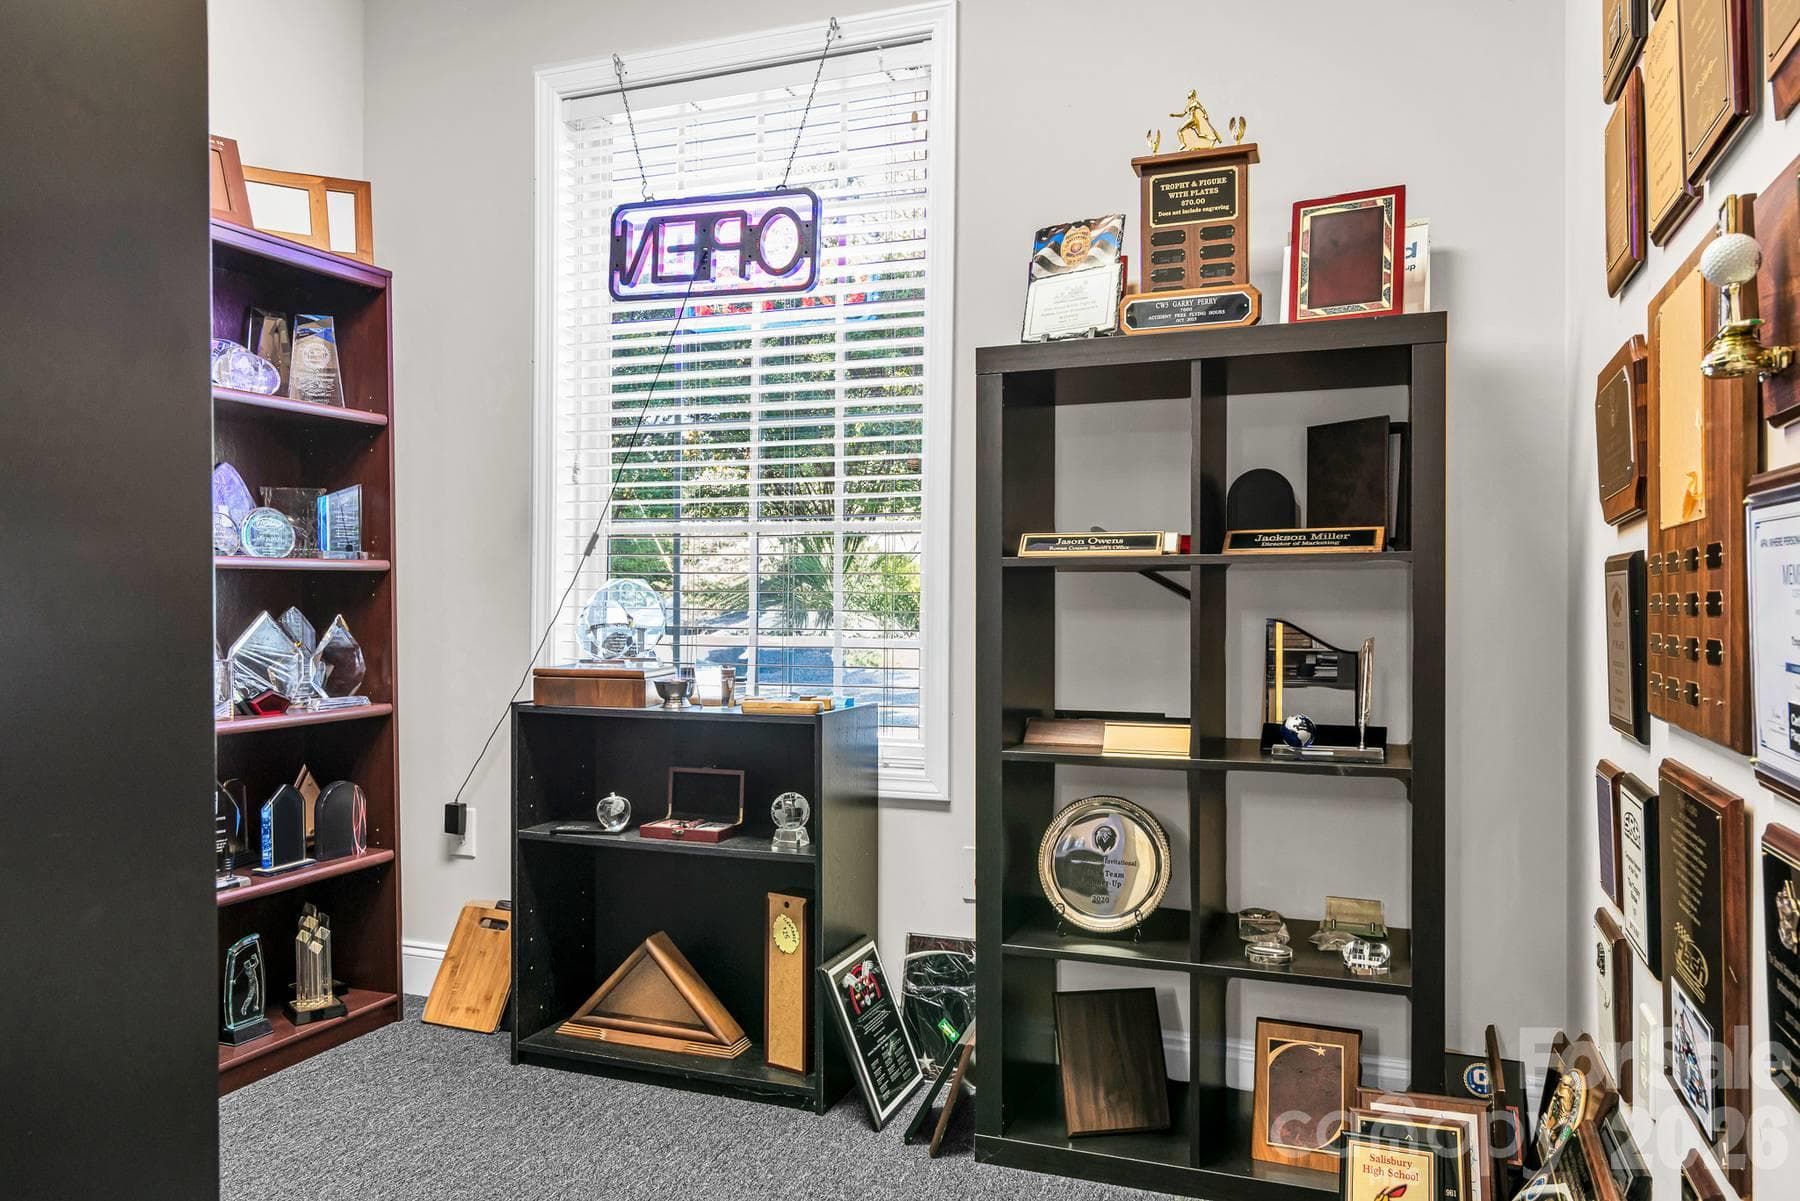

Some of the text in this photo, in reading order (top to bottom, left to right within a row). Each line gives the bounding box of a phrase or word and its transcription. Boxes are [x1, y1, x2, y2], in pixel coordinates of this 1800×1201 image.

[1160, 181, 1190, 191] TROPHY
[1198, 177, 1228, 187] FIGURE
[1168, 187, 1219, 199] WITH PLATES
[1202, 204, 1230, 213] engraving
[1055, 537, 1124, 546] Jason Owens
[1254, 531, 1351, 542] Jackson Miller
[1302, 539, 1341, 547] Marketing
[1104, 870, 1125, 879] Team
[1369, 1152, 1413, 1169] Salisbury
[1363, 1164, 1420, 1182] High School
